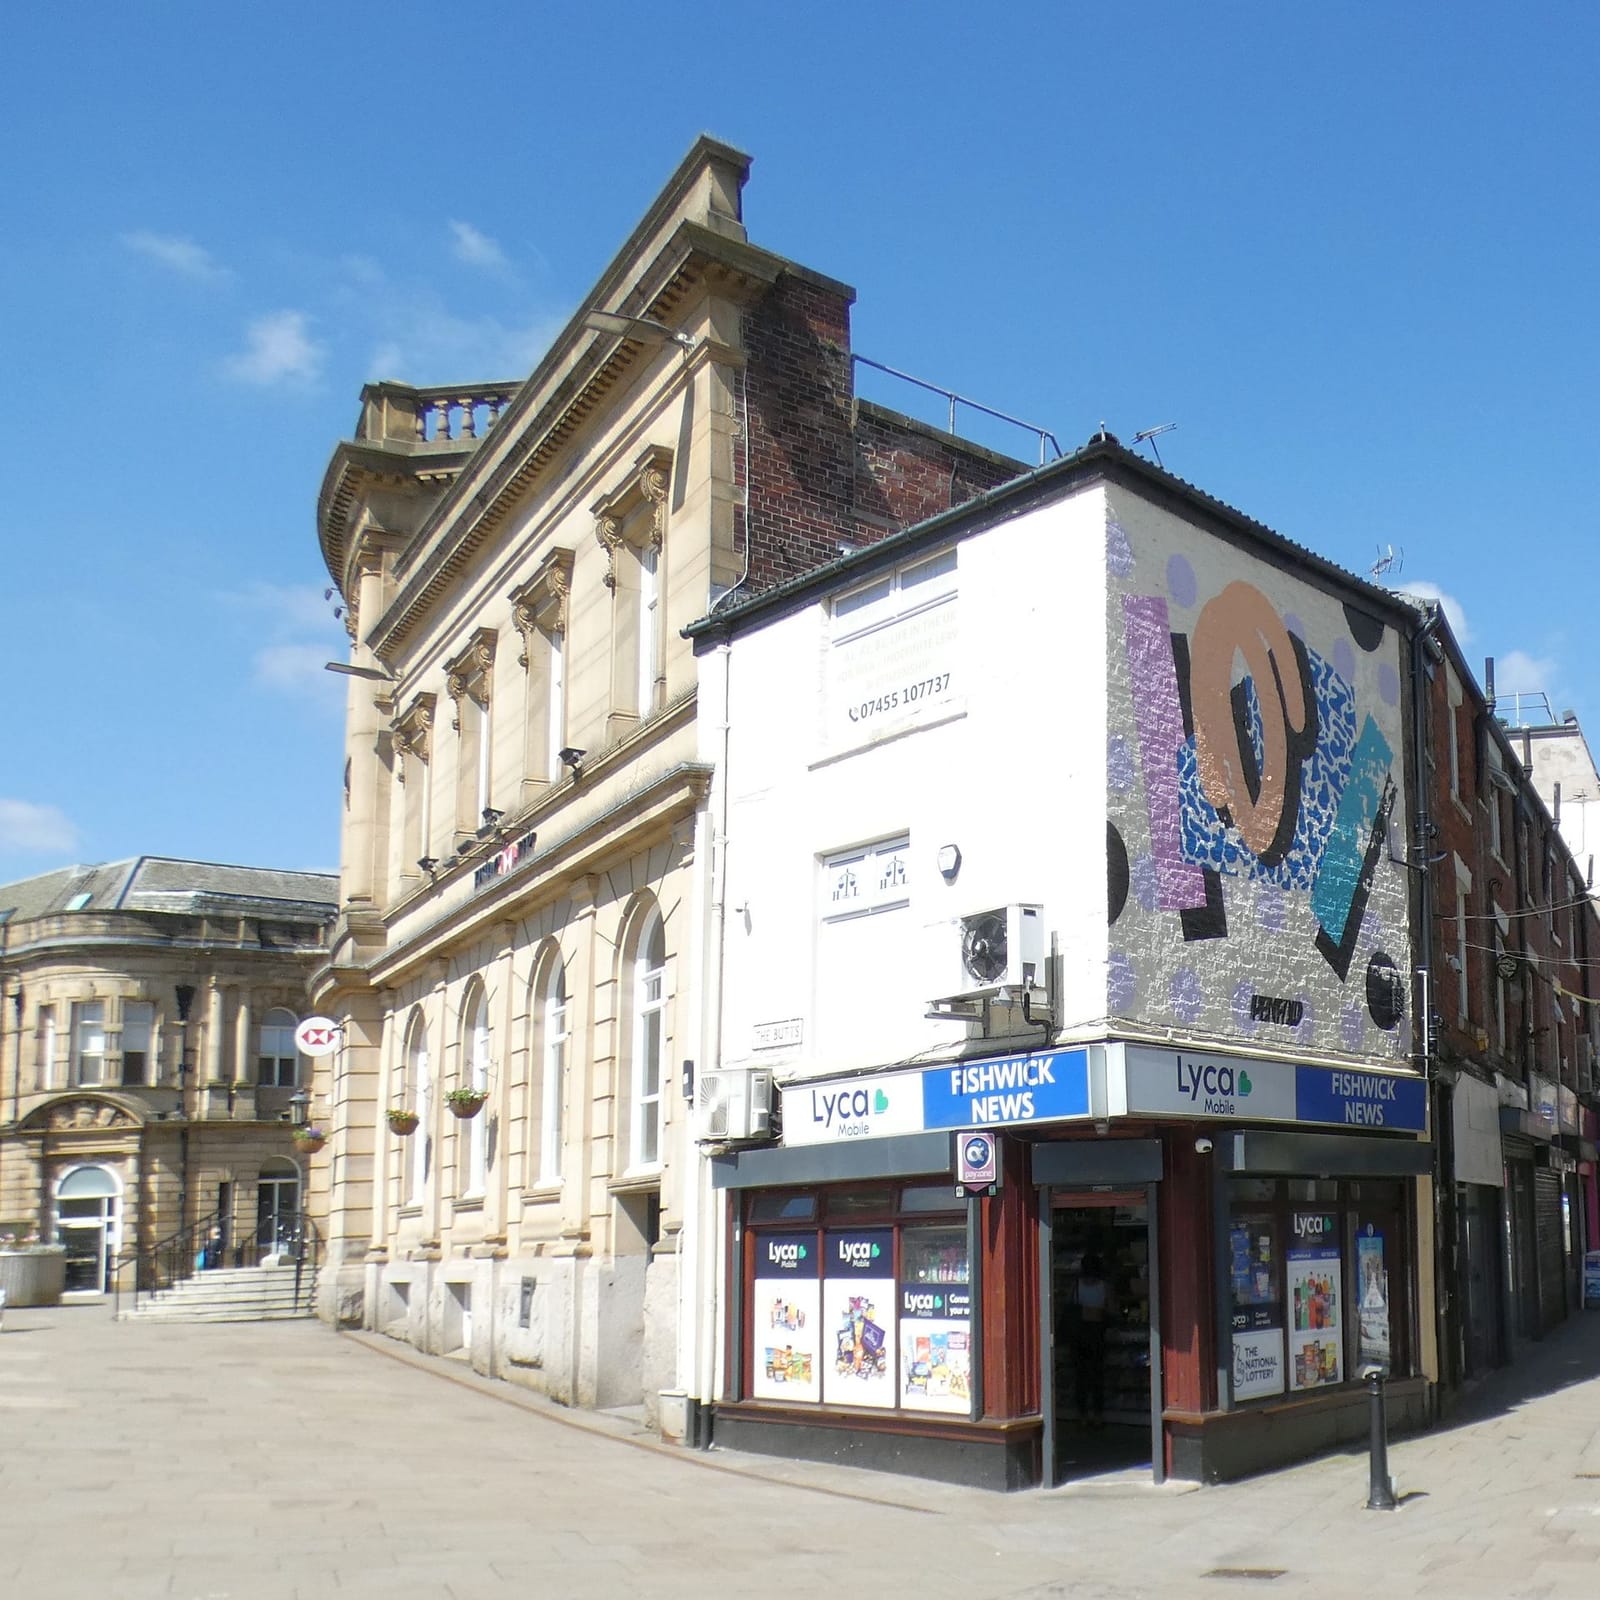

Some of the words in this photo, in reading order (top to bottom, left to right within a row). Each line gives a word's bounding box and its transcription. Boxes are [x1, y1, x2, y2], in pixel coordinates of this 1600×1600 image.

[861, 692, 898, 719] 07455
[903, 673, 950, 704] 107737
[773, 1025, 800, 1041] BUTTS
[951, 1057, 1055, 1095] FISHWICK
[1177, 1055, 1234, 1101] Lyca
[1331, 1072, 1396, 1101] FISHWICK
[812, 1089, 869, 1127] Lyca
[971, 1093, 1035, 1123] NEWS
[1204, 1098, 1235, 1115] Mobile
[1345, 1102, 1384, 1126] NEWS
[838, 1123, 870, 1137] Mobile
[1294, 1213, 1323, 1238] Lyca
[768, 1241, 798, 1264] Lyca
[839, 1240, 871, 1262] Lyca
[904, 1292, 934, 1312] Lyca
[1231, 1315, 1246, 1327] yca
[1245, 1346, 1258, 1358] THE
[1245, 1356, 1278, 1369] NATIONAL
[1245, 1368, 1275, 1382] LOTTERY
